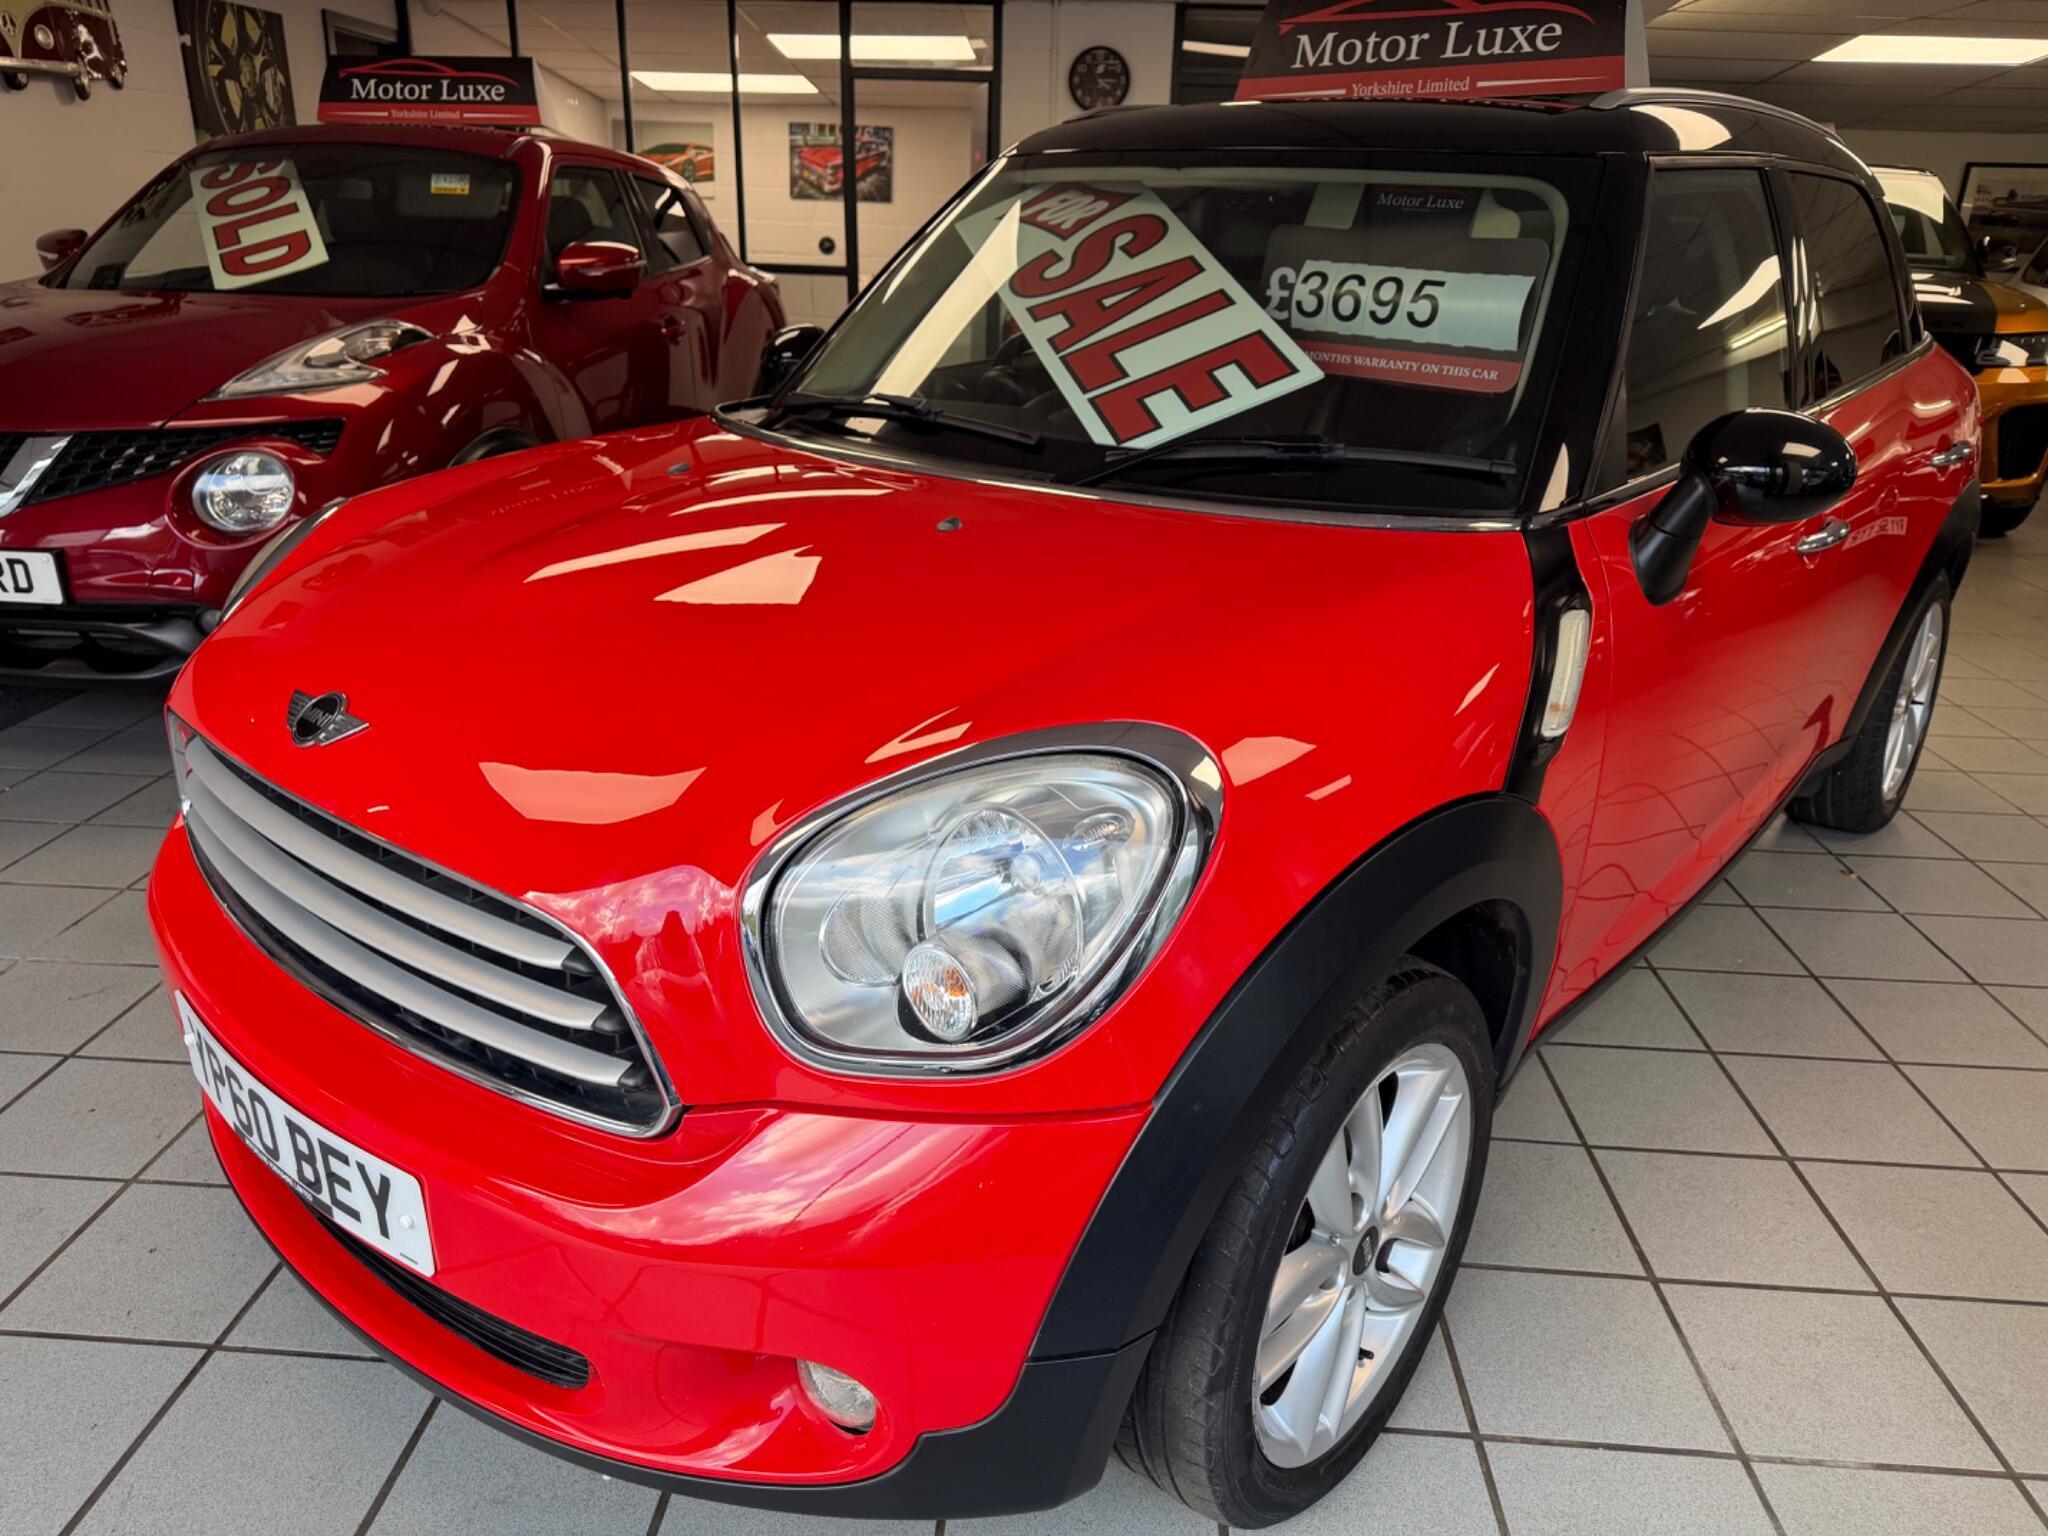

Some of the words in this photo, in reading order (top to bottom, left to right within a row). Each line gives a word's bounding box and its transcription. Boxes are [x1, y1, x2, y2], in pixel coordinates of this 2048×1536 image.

[1290, 31, 1430, 69] Motor
[1440, 21, 1563, 59] Luxe
[350, 78, 433, 100] Motor
[440, 79, 506, 101] Luxe
[1351, 79, 1414, 97] Yorkshire
[1417, 76, 1471, 94] Limited
[200, 160, 312, 277] SOLD
[1021, 189, 1110, 230] FOR
[1376, 193, 1425, 207] Motor
[1426, 194, 1465, 209] Luxe
[1265, 265, 1448, 328] £3695
[1008, 213, 1301, 446] SALE
[1352, 355, 1421, 372] WARRANTY
[1420, 363, 1440, 374] ON
[1441, 364, 1470, 378] THIS
[1471, 368, 1499, 381] CAR
[186, 1014, 281, 1163] YP60
[284, 1114, 392, 1241] BEY
